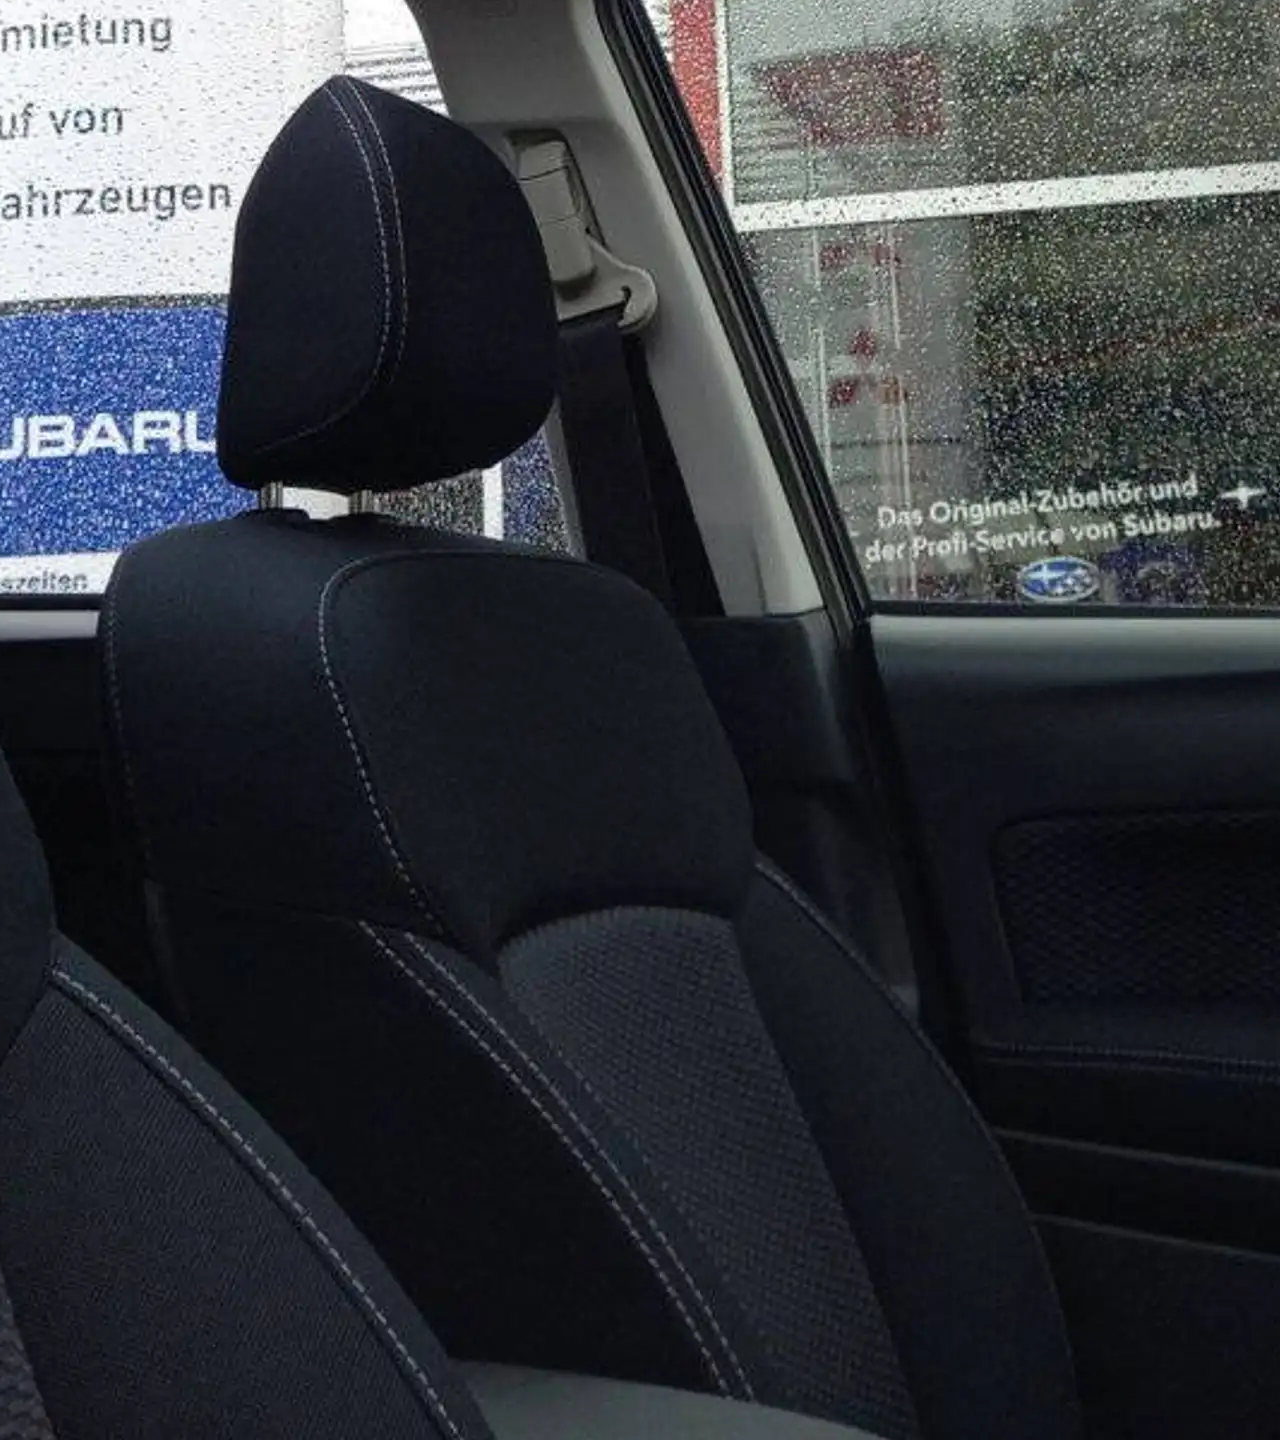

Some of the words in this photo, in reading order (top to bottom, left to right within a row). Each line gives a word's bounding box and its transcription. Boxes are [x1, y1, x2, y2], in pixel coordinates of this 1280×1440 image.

[50, 106, 126, 136] von
[877, 504, 923, 530] Das
[928, 480, 1145, 528] Original-Zubehör
[1148, 473, 1199, 502] und
[864, 537, 905, 563] der
[911, 523, 1066, 561] Profi-Service
[1070, 524, 1118, 543] von
[1124, 511, 1222, 539] Subaru.
